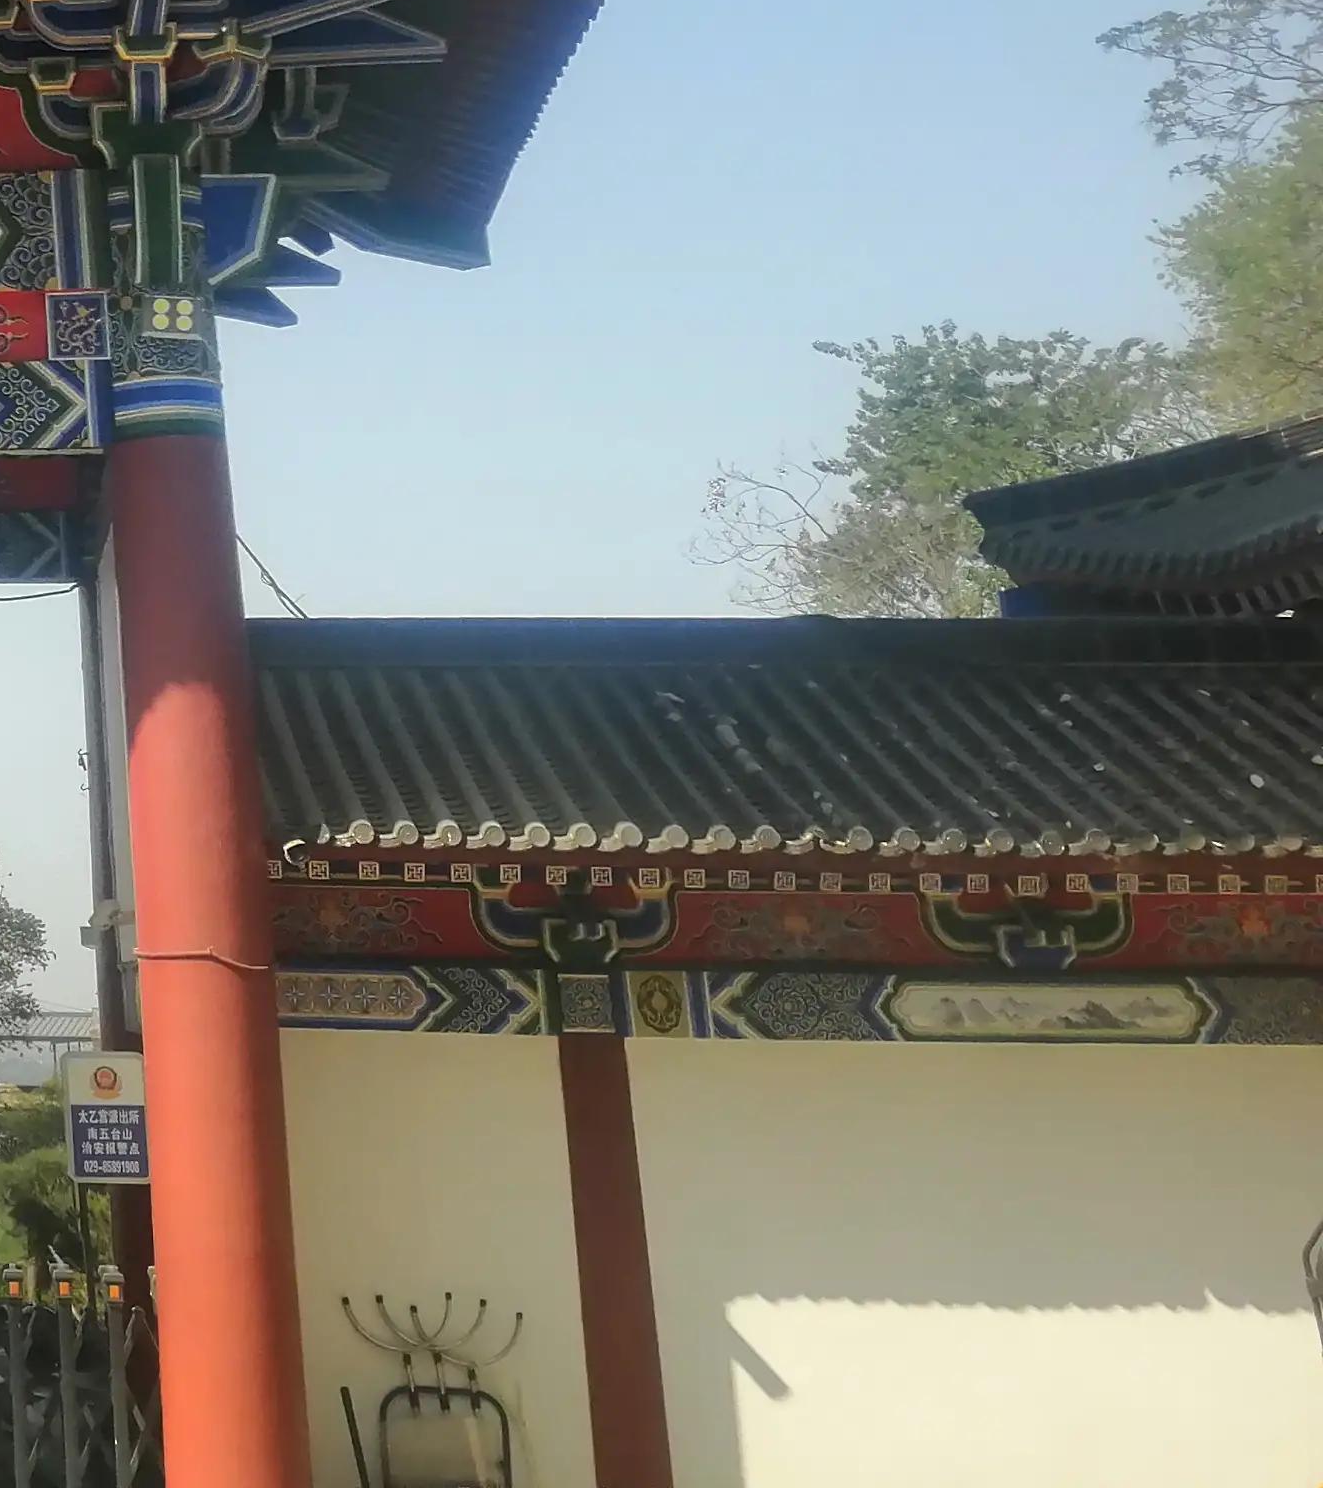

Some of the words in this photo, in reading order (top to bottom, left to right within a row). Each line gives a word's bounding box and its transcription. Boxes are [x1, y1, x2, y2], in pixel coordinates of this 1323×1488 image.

[87, 1127, 133, 1141] 南五台山
[81, 1142, 140, 1155] 治安报警点
